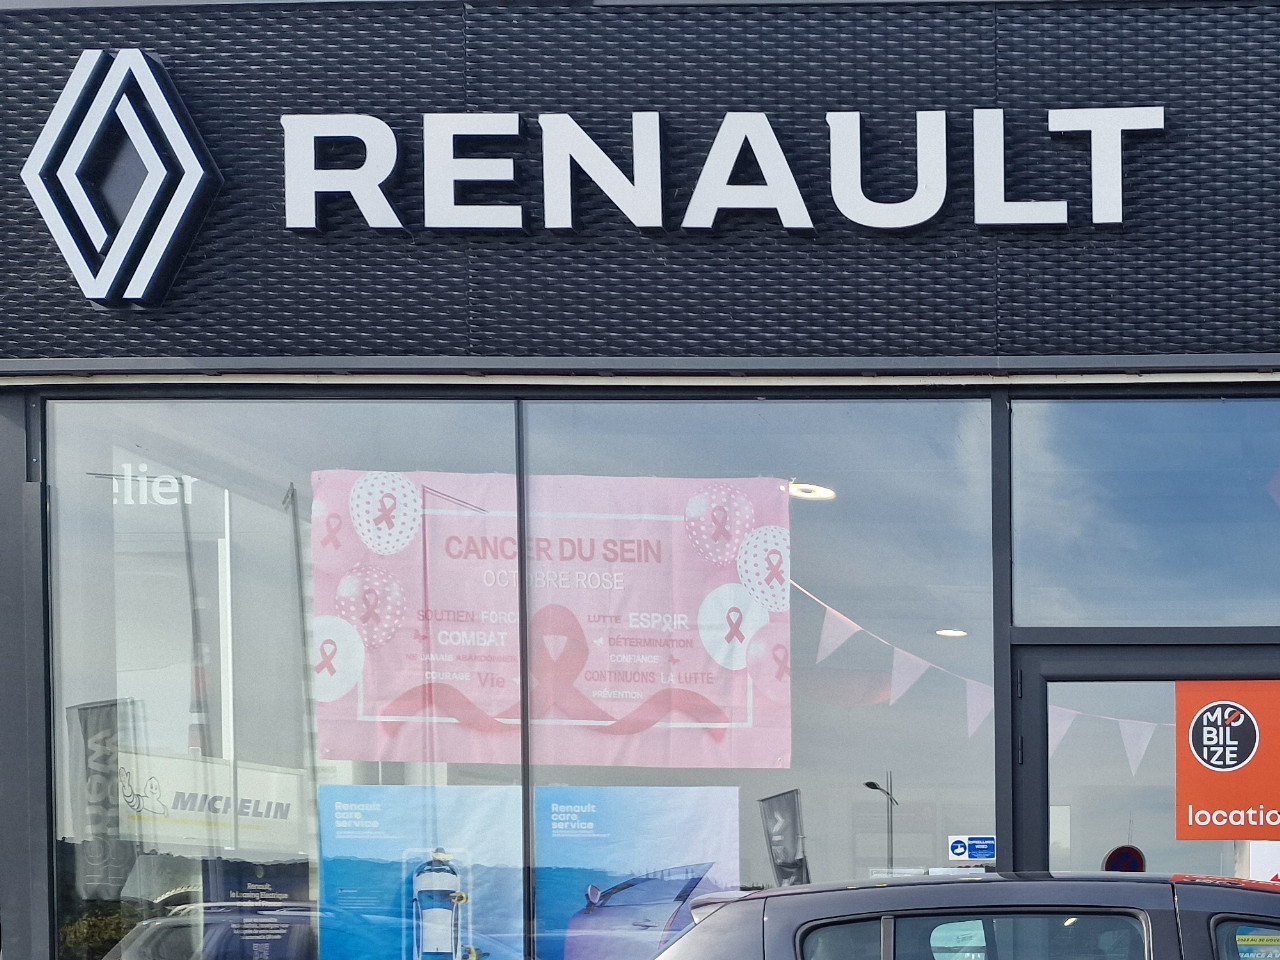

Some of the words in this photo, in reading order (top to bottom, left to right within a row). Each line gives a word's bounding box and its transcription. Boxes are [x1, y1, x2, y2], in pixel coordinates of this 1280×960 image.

[280, 106, 1165, 231] RENAULT
[558, 537, 595, 562] DU
[602, 539, 662, 563] SEIN
[483, 569, 570, 589] OCTBRE
[576, 572, 624, 590] ROSE
[417, 609, 475, 623] SOUTIEN
[588, 614, 621, 623] LUTTE
[437, 630, 508, 647] COMBAT
[608, 635, 694, 648] DÉTERMINATION
[609, 654, 660, 663] CONFIANCE
[425, 671, 472, 681] COURAGE
[584, 670, 656, 683] CONTINUONS
[661, 672, 675, 684] LA
[678, 672, 714, 684] LUTTE
[552, 803, 597, 813] Renault
[552, 813, 578, 821] care
[552, 820, 594, 829] service
